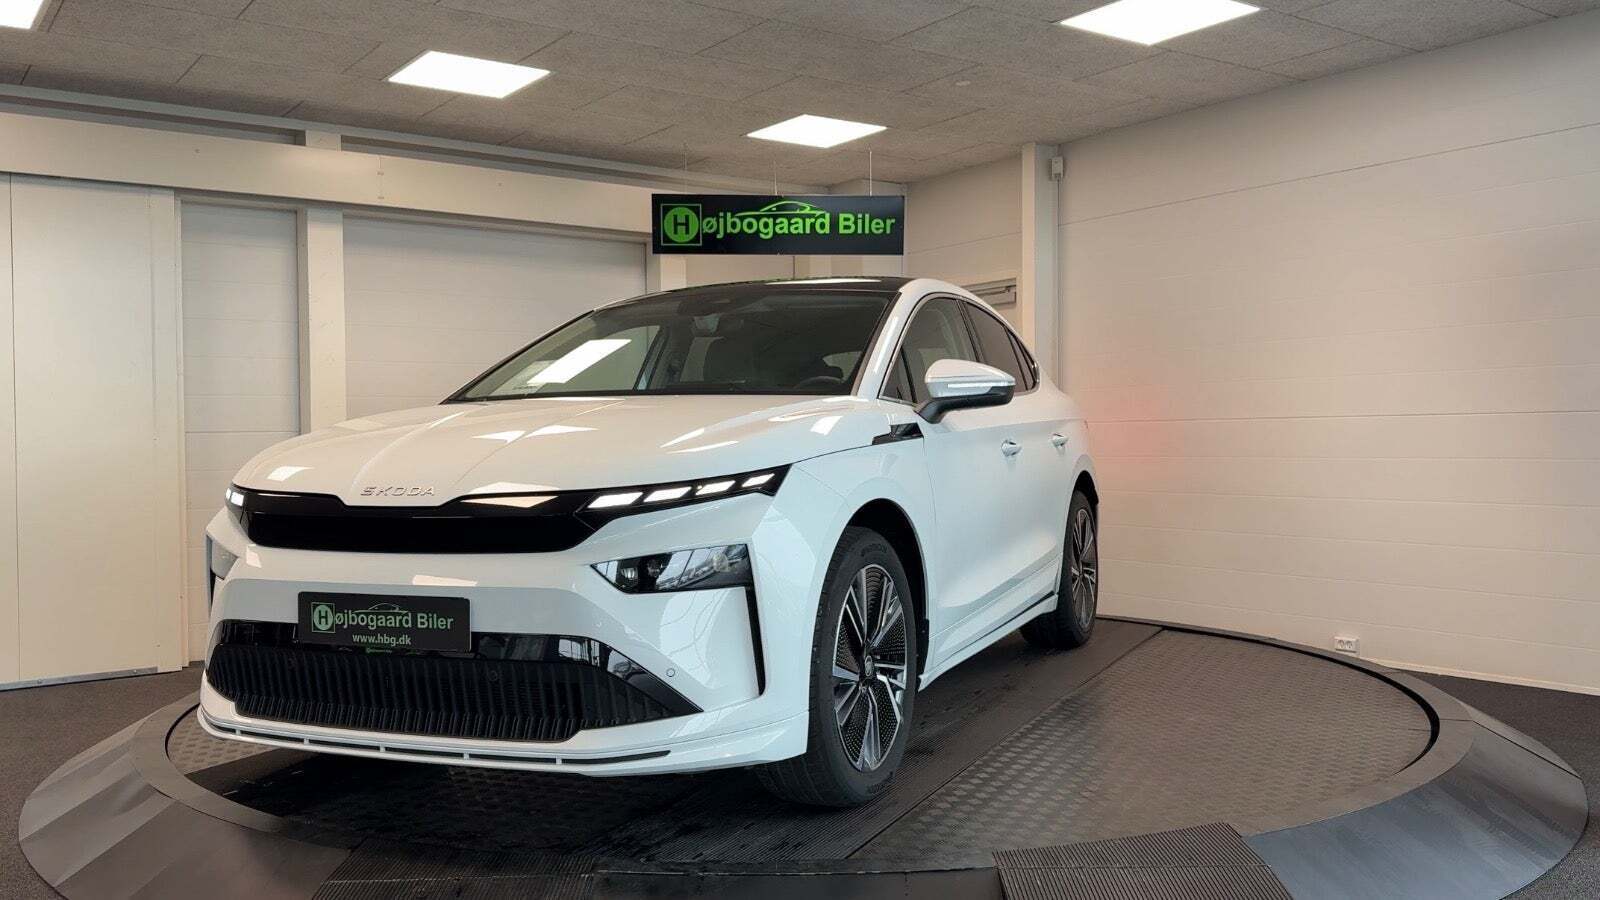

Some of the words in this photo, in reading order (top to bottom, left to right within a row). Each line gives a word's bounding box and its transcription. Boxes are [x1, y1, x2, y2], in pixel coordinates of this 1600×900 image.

[672, 212, 830, 240] Højbogaard
[838, 212, 896, 235] Biler
[317, 609, 412, 630] Højbogaard
[417, 612, 454, 630] Biler
[352, 633, 412, 647] www.hbg.dk
